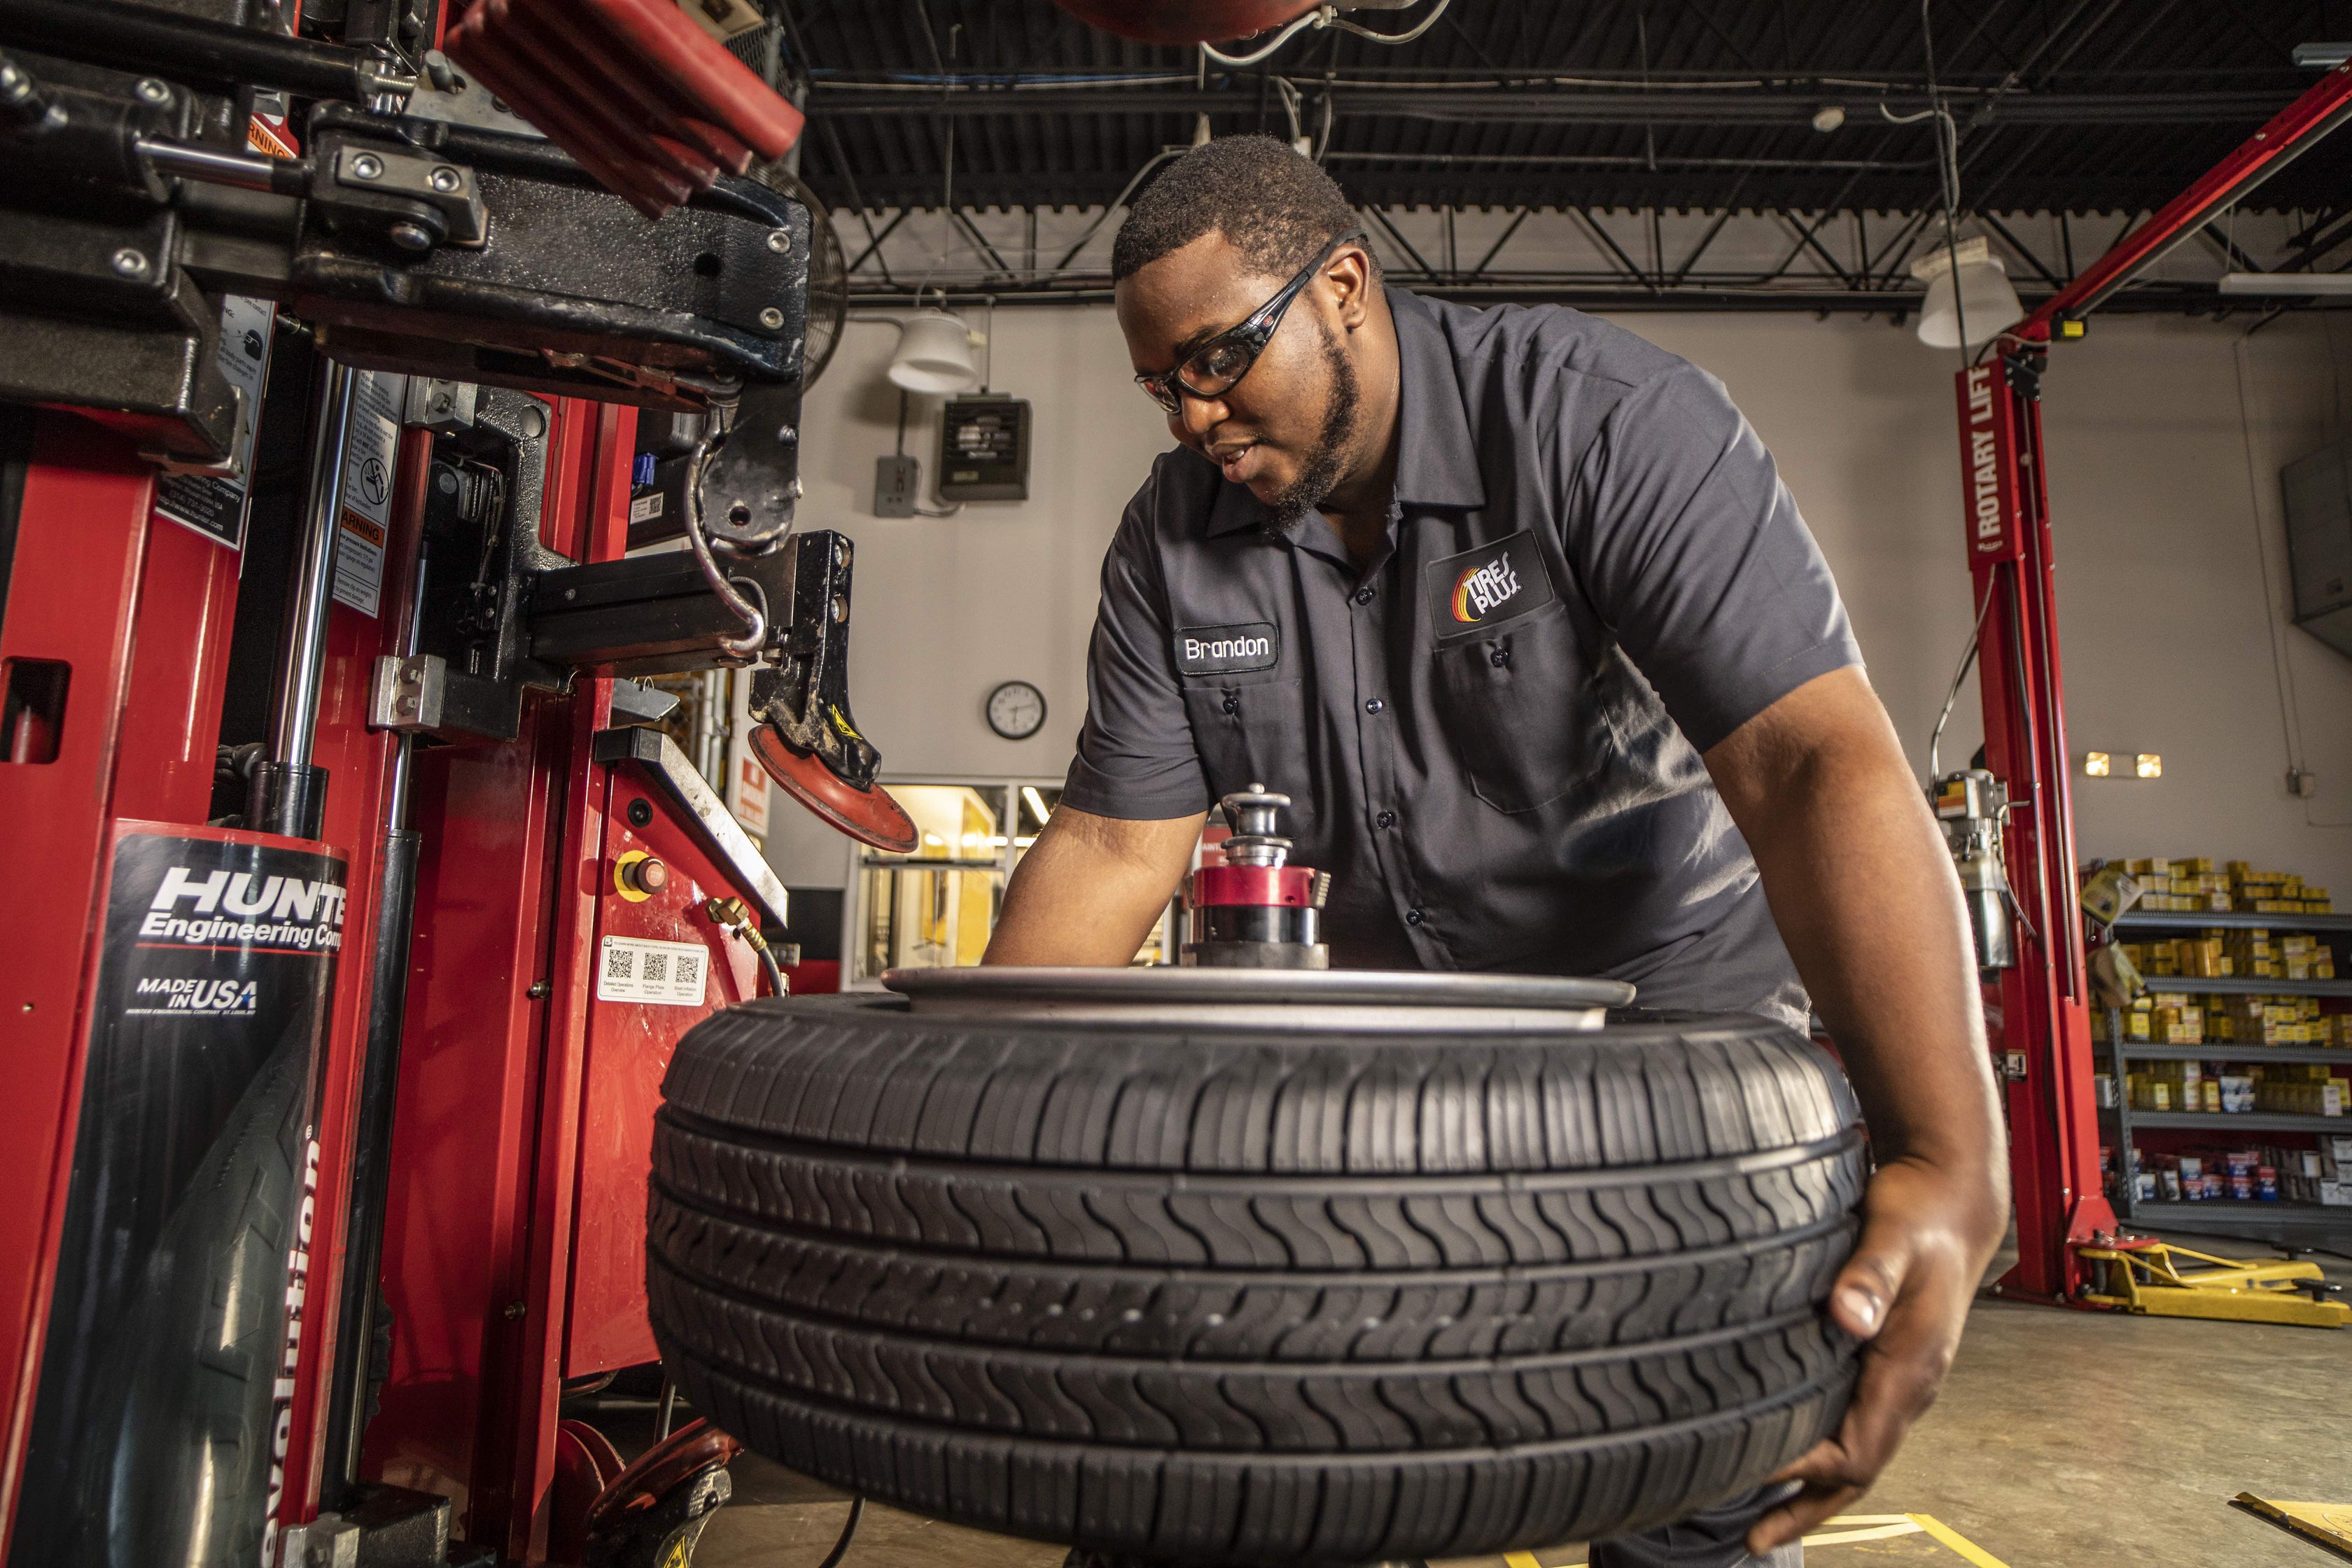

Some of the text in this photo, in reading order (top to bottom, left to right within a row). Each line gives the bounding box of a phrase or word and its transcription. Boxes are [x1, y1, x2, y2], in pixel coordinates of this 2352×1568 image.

[1968, 366, 1994, 424] LIFT
[1971, 430, 2001, 539] ROTARY
[1463, 550, 1509, 600] TIRES
[1474, 570, 1518, 615] PLUS
[1184, 636, 1269, 660] Brandon
[650, 870, 662, 880] STOP
[139, 911, 315, 949] Engineering
[136, 978, 258, 1009] MADE IN USA
